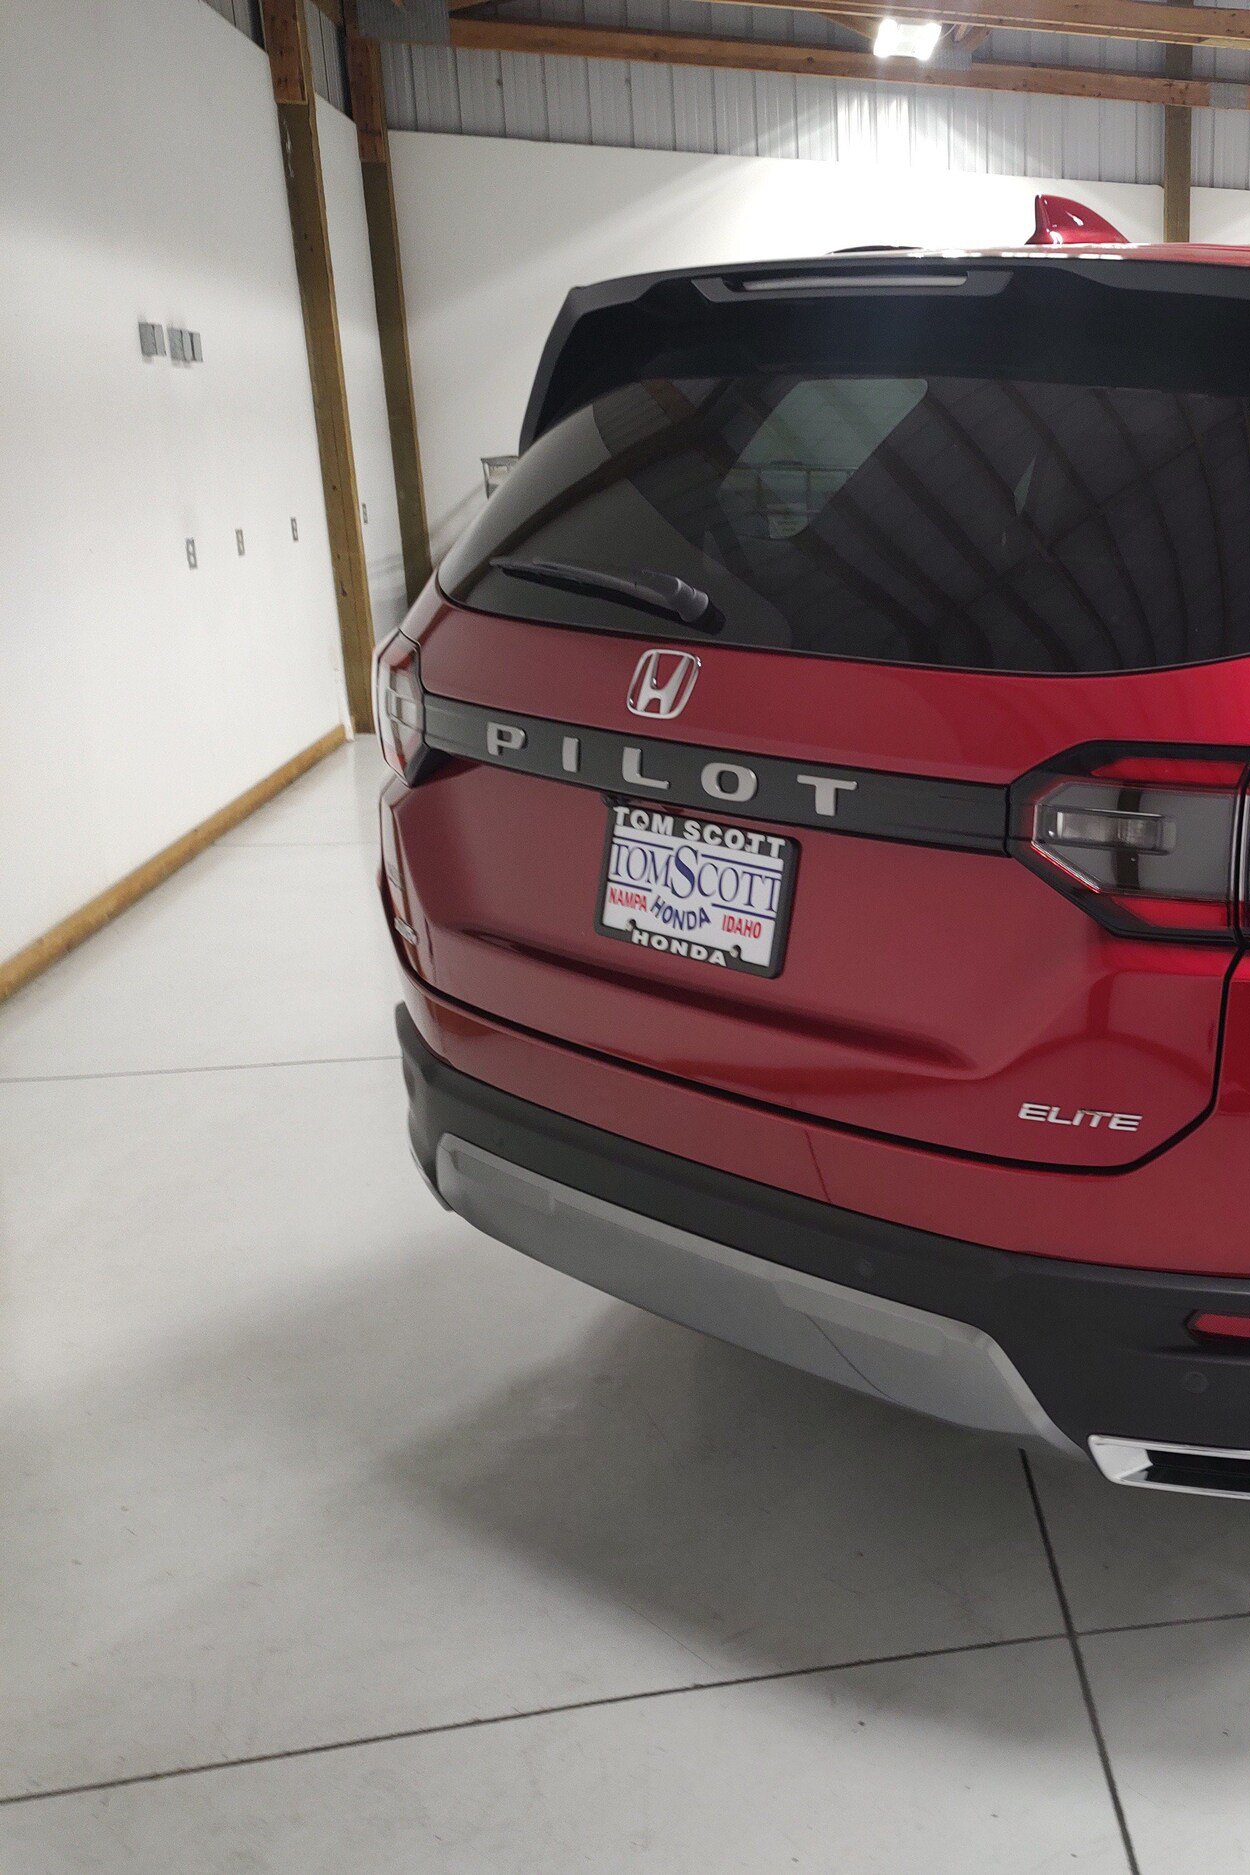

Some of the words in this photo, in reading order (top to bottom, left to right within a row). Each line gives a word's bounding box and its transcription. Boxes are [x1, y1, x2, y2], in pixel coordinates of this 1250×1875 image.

[487, 721, 858, 816] PILOT
[613, 806, 674, 835] TOM
[683, 820, 786, 858] SCOTT
[609, 887, 647, 911] NAMPA
[650, 895, 711, 931] HONDA
[721, 914, 762, 939] IDAHO
[631, 930, 727, 966] HONDA
[1018, 1103, 1143, 1132] ELITE
